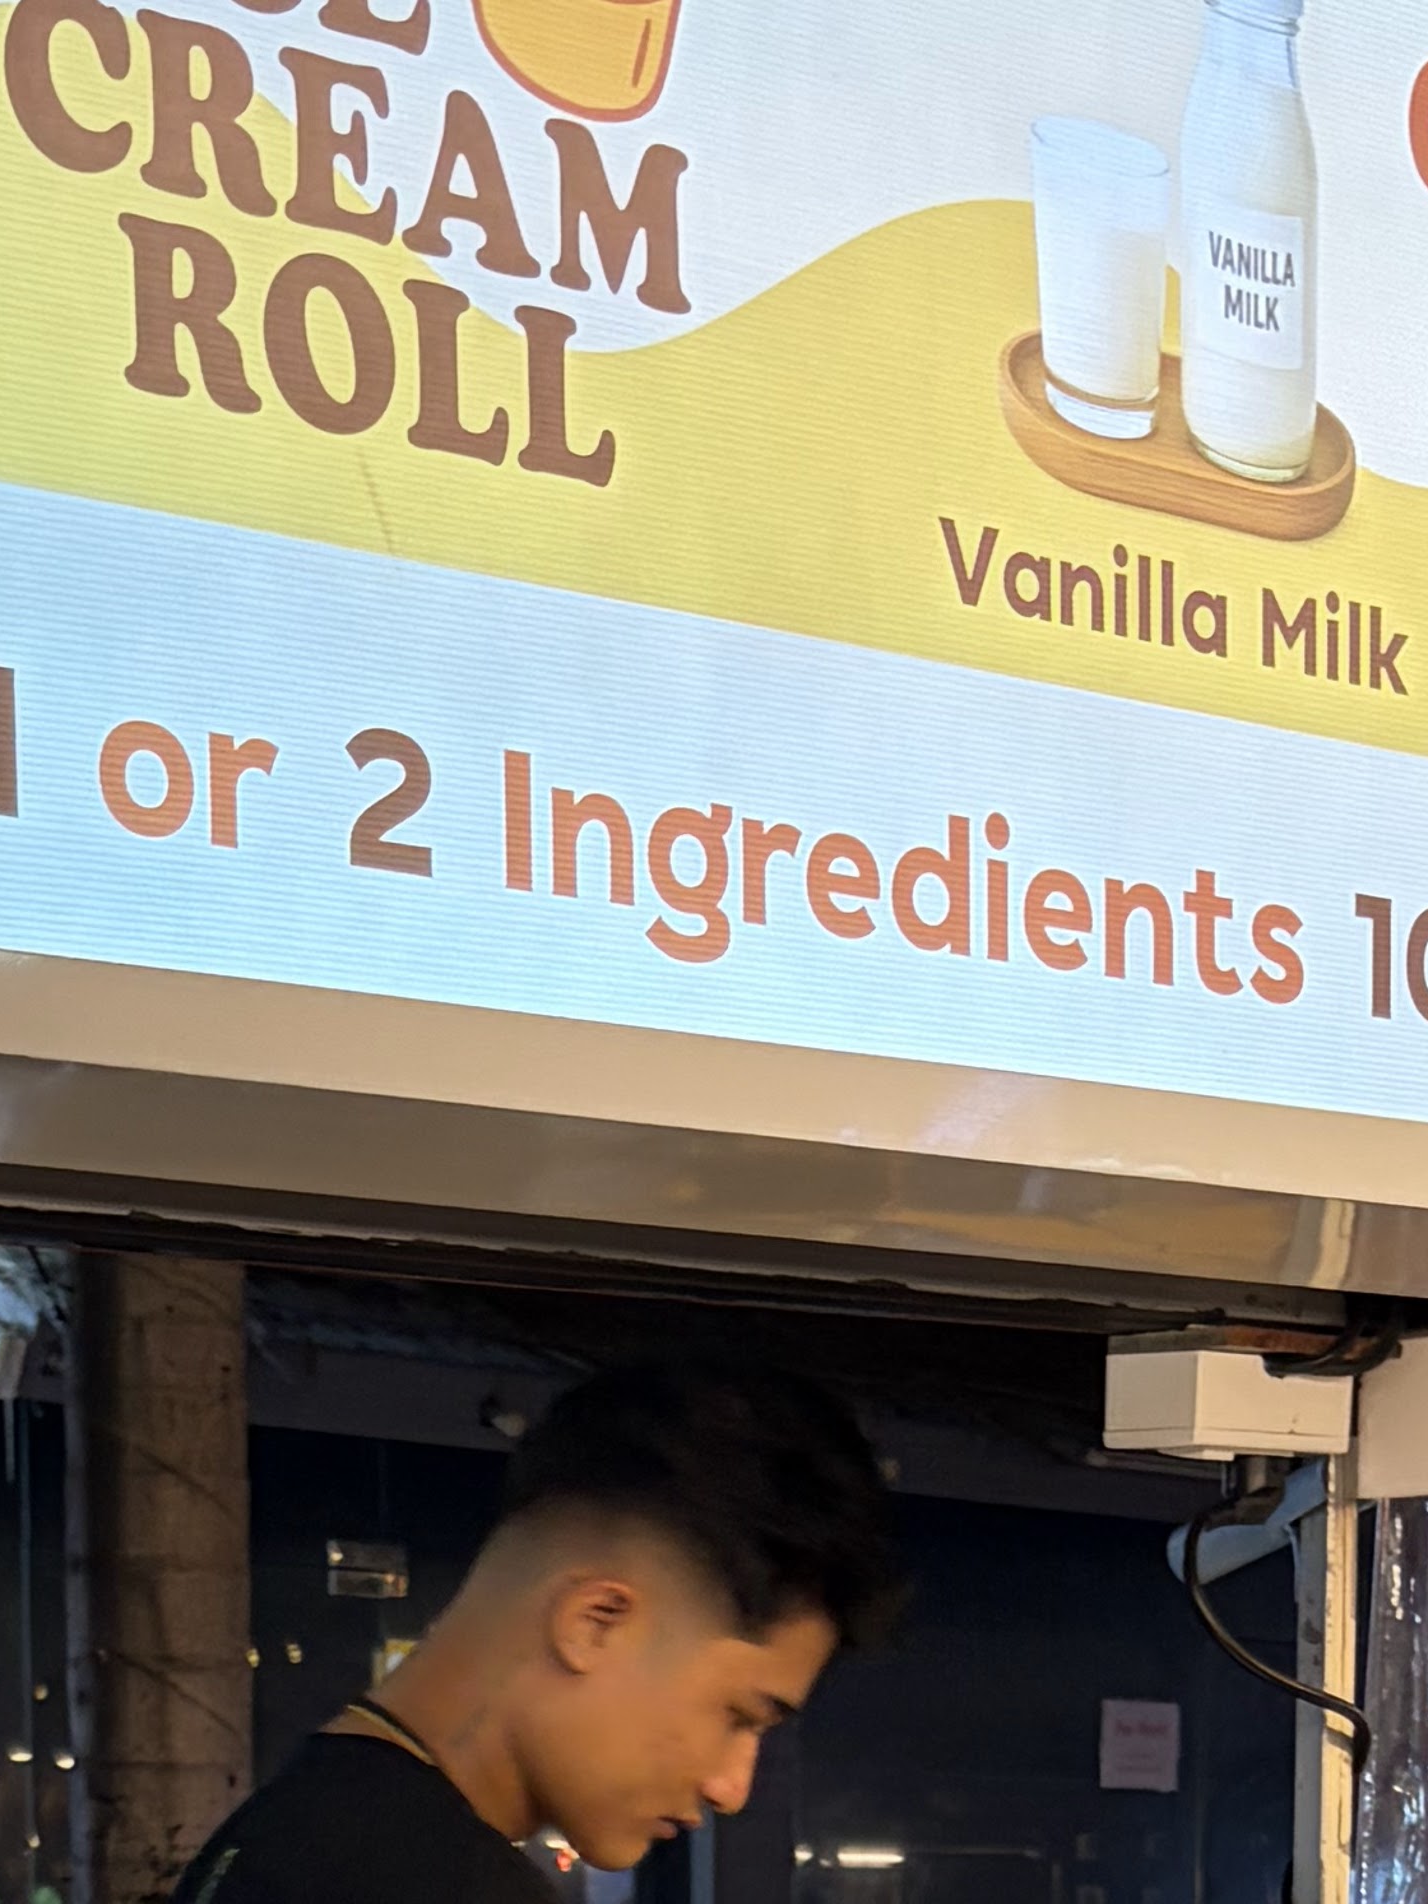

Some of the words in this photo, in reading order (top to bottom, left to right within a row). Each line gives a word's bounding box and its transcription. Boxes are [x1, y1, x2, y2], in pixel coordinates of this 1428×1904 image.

[4, 0, 691, 314] CREAM
[1208, 230, 1295, 287] VANILLA
[119, 212, 615, 488] ROLL
[1223, 285, 1280, 332] MILK
[938, 516, 1227, 658] Vanilla
[1262, 586, 1409, 696] Milk
[99, 720, 279, 848] or
[345, 727, 433, 877] 2
[504, 750, 1304, 1004] Ingredients
